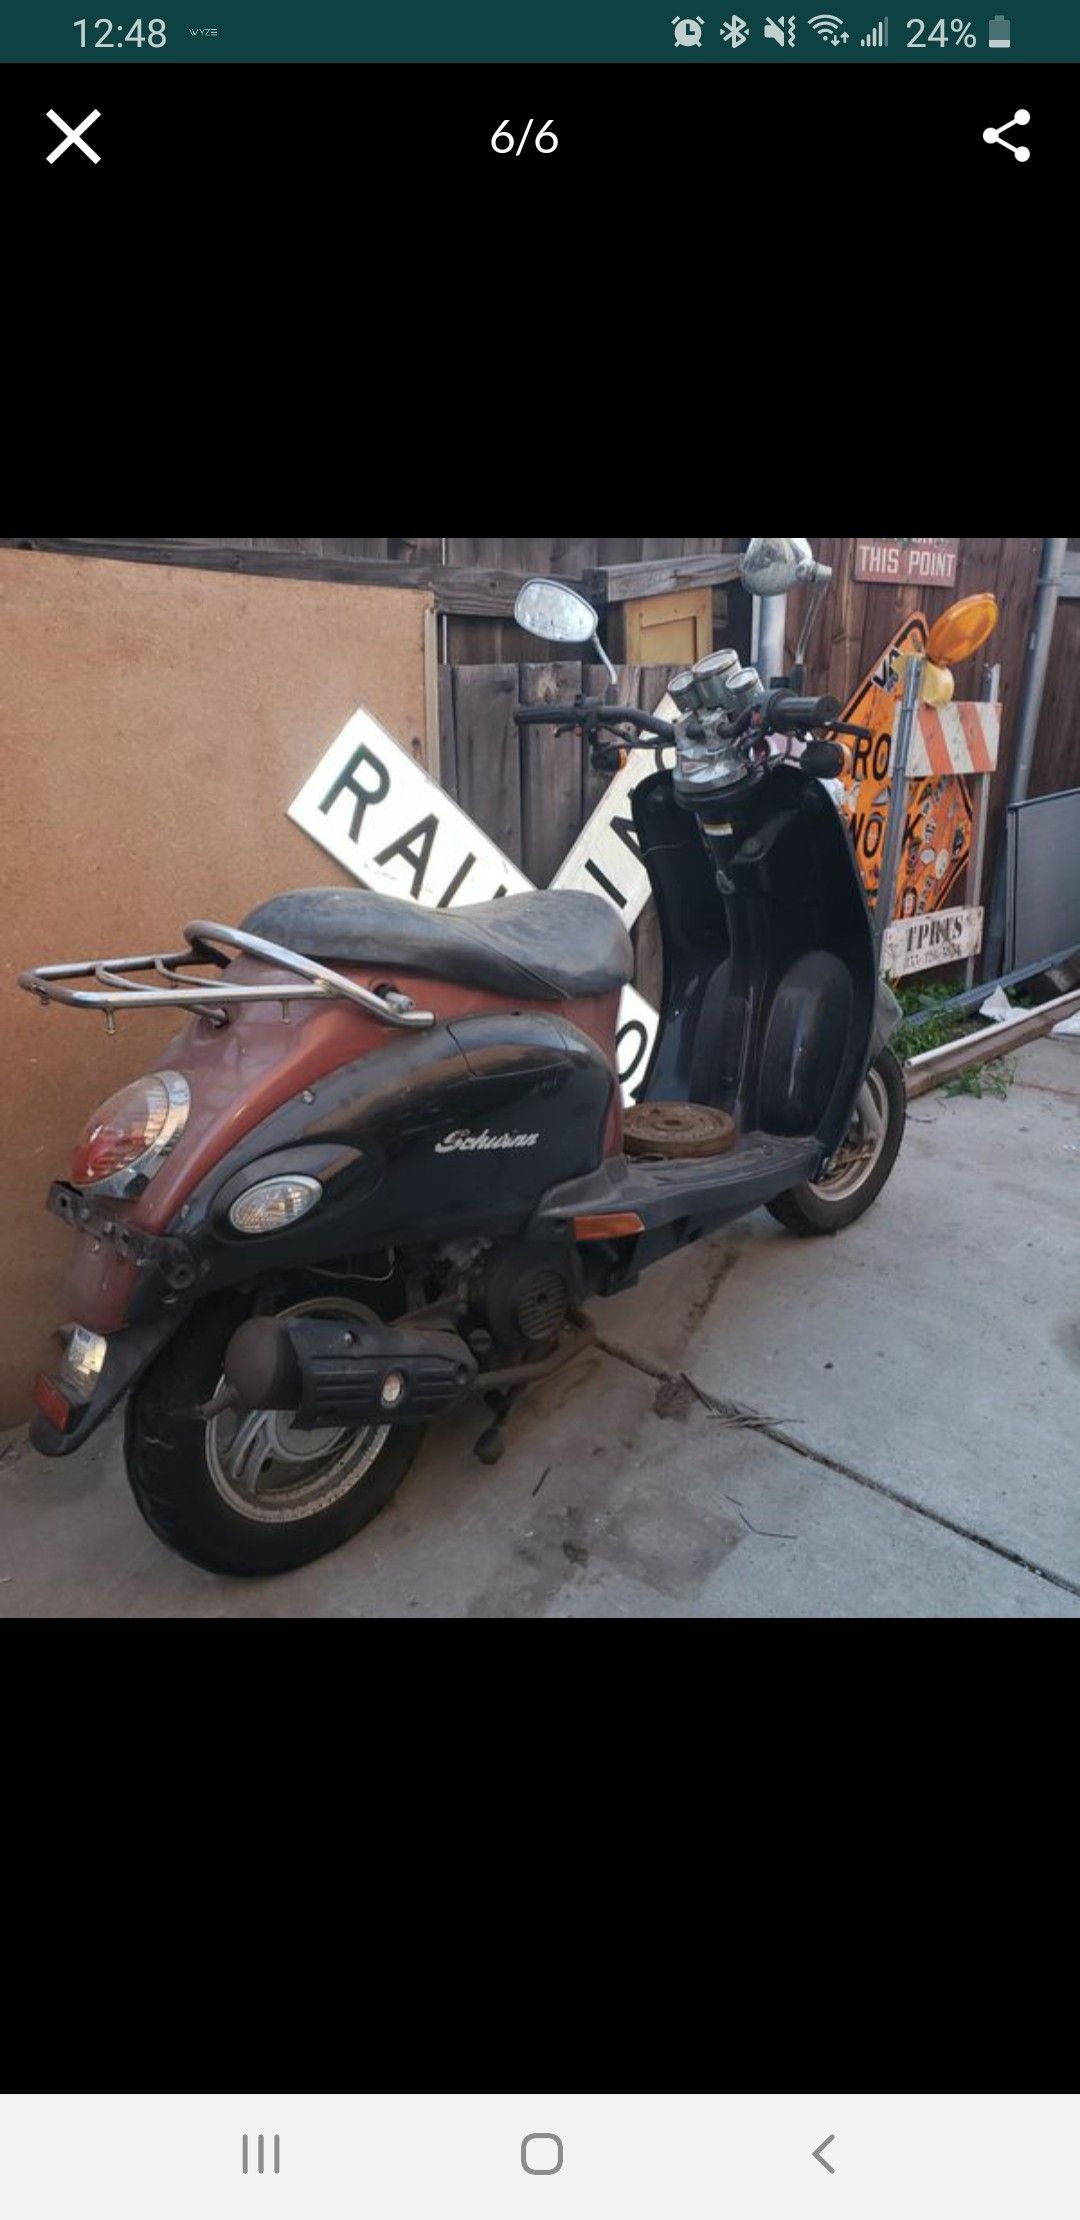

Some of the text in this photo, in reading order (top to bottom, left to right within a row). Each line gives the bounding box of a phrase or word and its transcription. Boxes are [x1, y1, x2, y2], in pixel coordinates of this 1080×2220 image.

[859, 545, 956, 577] THIS POINT
[318, 742, 508, 908] RAI
[435, 1128, 540, 1154] Schwinn
